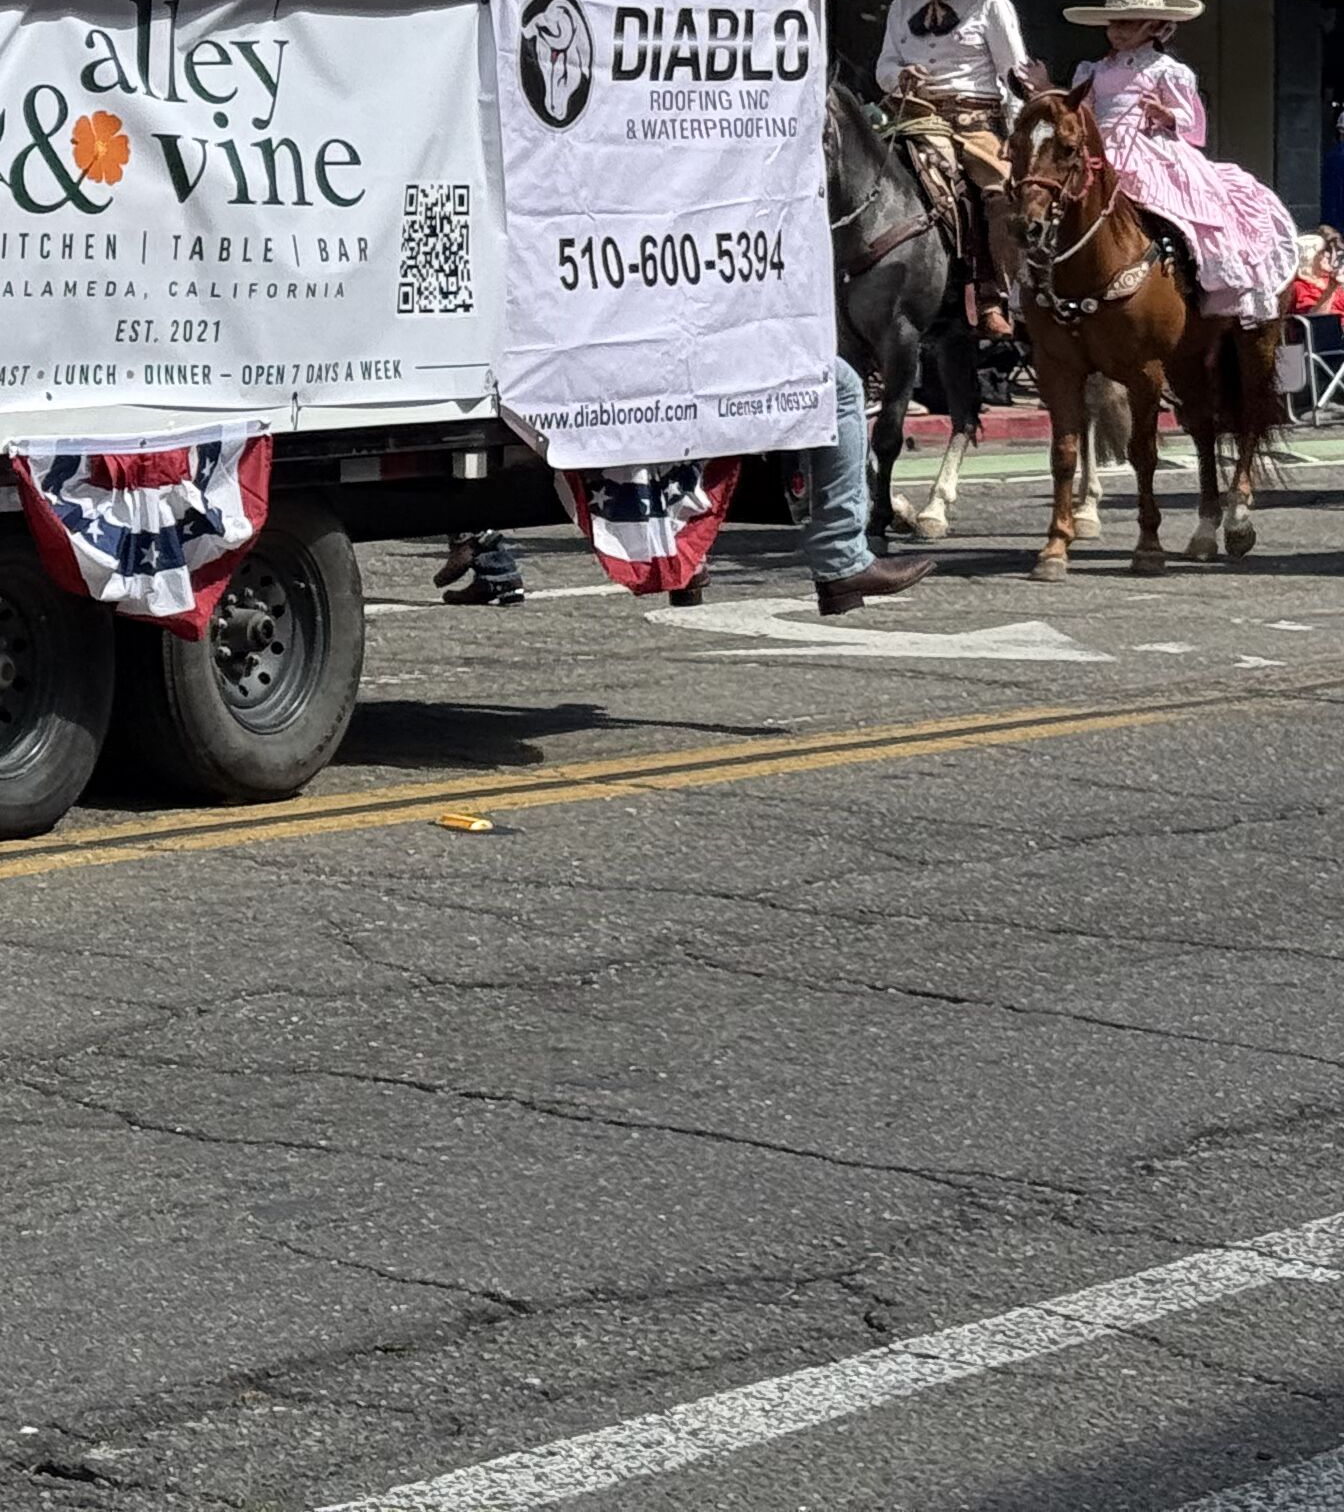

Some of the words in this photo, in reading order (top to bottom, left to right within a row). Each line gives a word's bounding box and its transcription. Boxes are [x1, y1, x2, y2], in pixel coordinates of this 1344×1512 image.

[611, 7, 810, 82] DIABLO
[650, 90, 732, 111] ROOFING
[739, 89, 770, 110] INC
[626, 121, 639, 140] &
[641, 117, 797, 140] WATERPROOFING
[150, 110, 366, 207] vine
[173, 235, 273, 262] TABLE
[318, 237, 368, 262] BAR
[559, 229, 784, 291] 510-600-5394
[3, 280, 147, 299] ALAMEDA,
[169, 281, 344, 299] CALIFORNIA
[115, 320, 158, 343] EST.
[170, 320, 220, 343] 2021
[54, 364, 116, 385] LUNCH
[145, 364, 211, 385] DINNER
[242, 365, 285, 385] OPEN
[292, 364, 300, 384] 7
[306, 362, 339, 383] DAYS
[345, 361, 354, 381] A
[360, 360, 401, 380] WEEK
[717, 396, 764, 418] License
